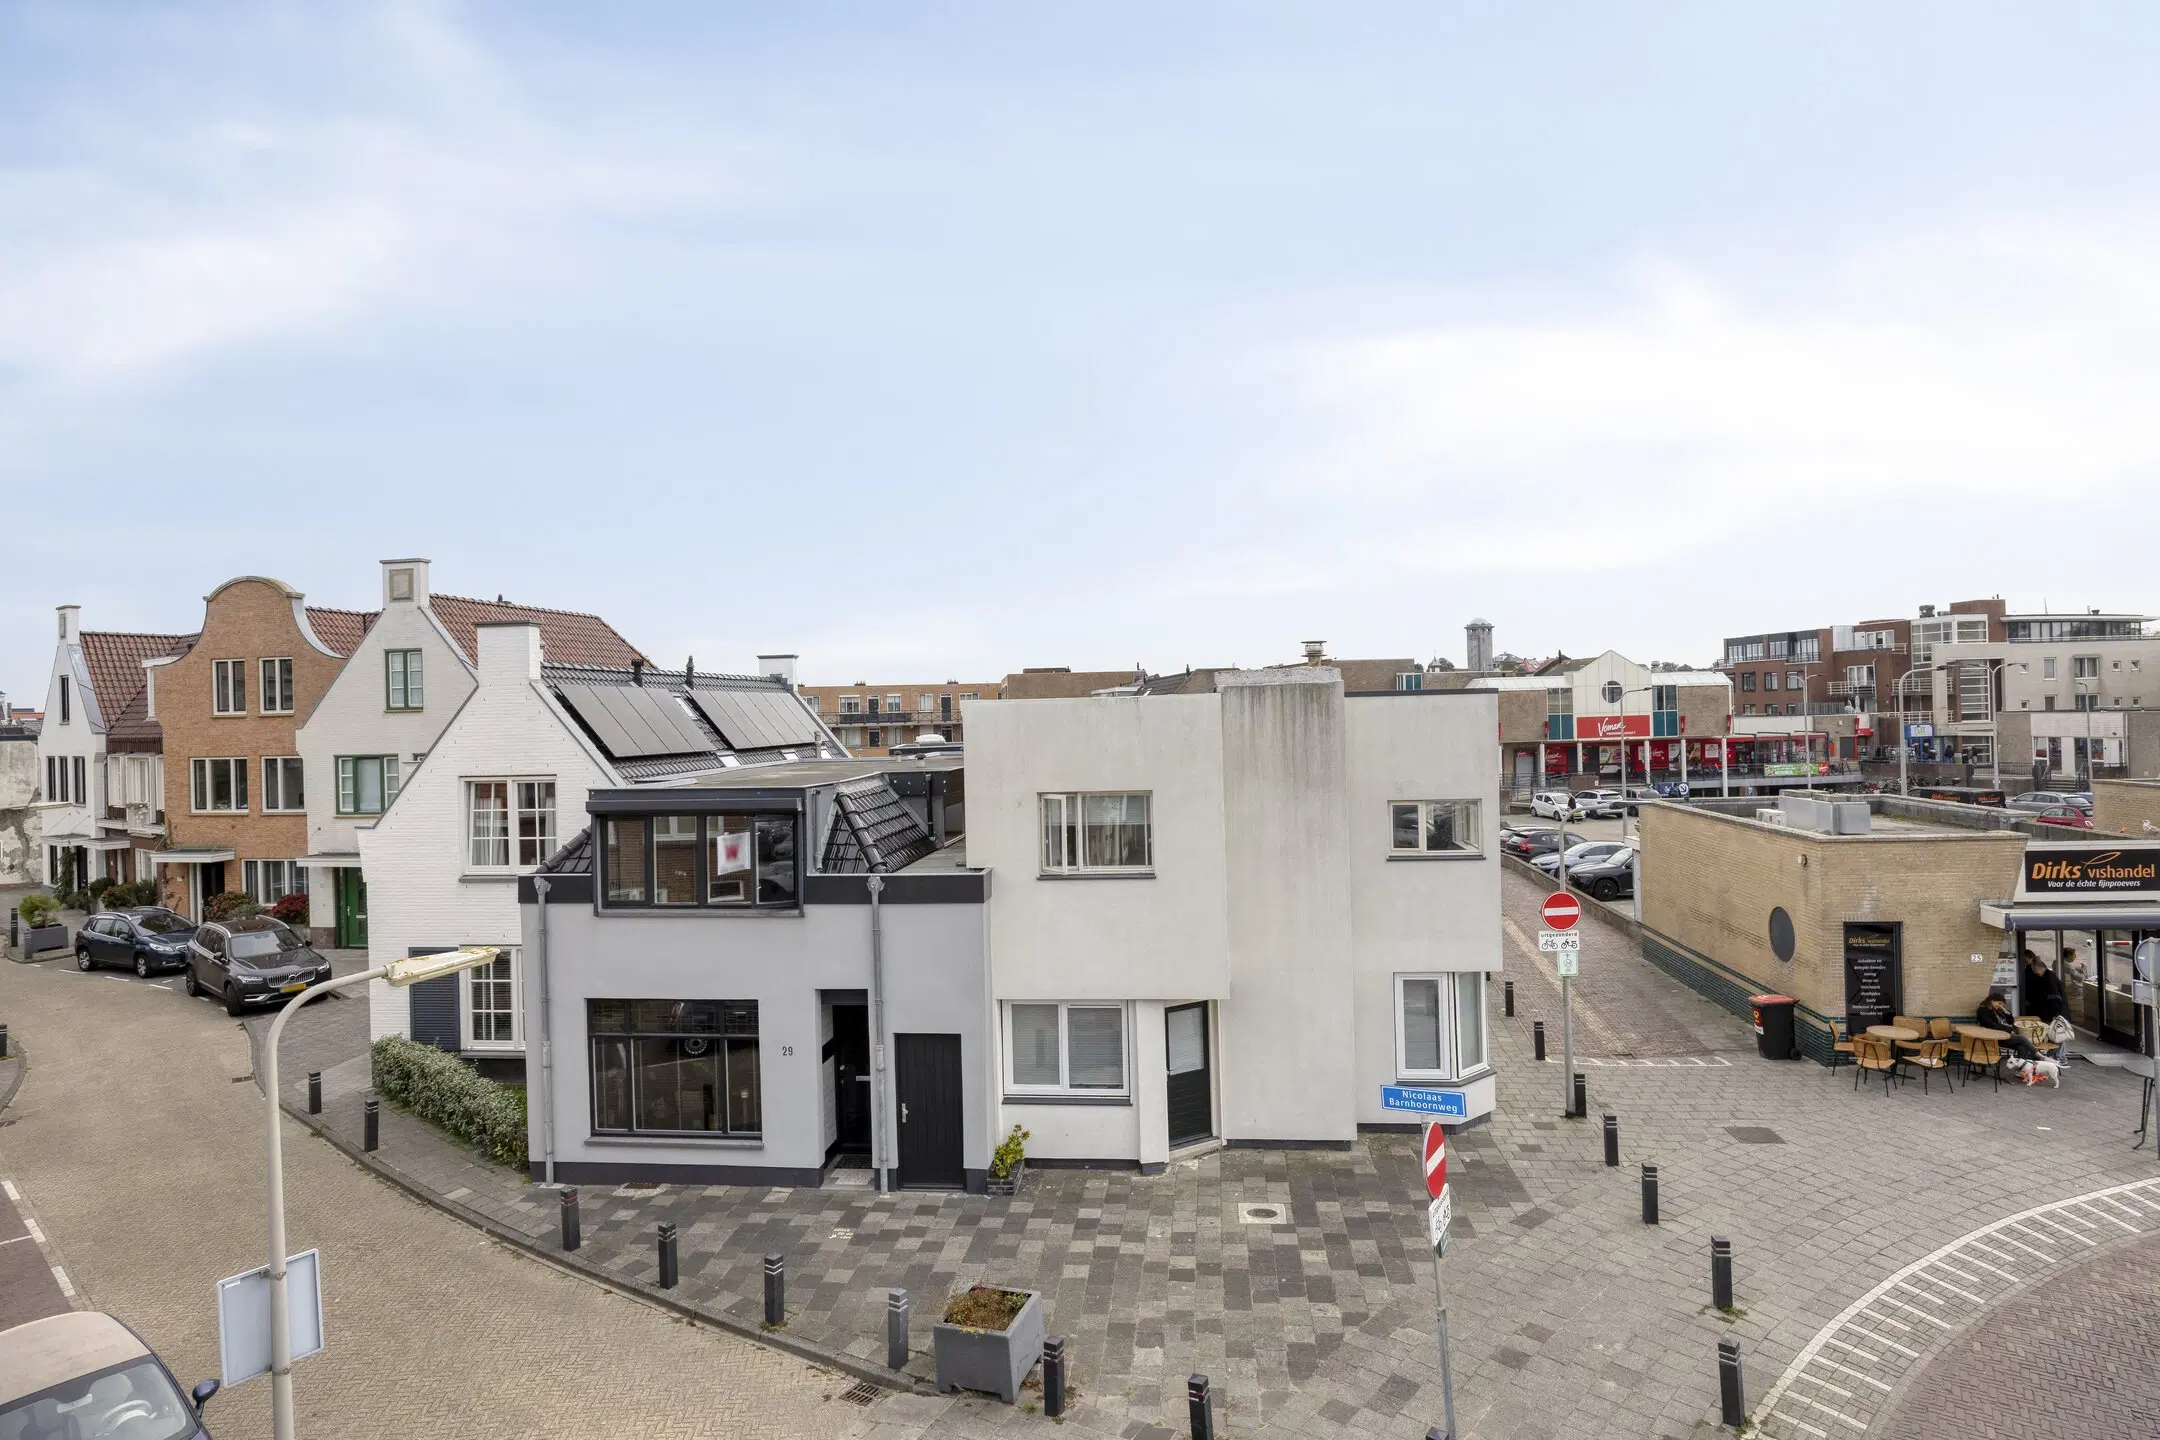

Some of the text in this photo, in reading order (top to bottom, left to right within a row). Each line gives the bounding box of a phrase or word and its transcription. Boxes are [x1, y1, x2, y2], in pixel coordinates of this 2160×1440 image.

[2032, 860, 2155, 879] Dirks vishandel
[2048, 879, 2141, 889] Voor de échte fijnproevers
[782, 1046, 793, 1056] 29
[1402, 1090, 1442, 1102] Nicolaas
[1389, 1098, 1458, 1113] Barnhoornweg
